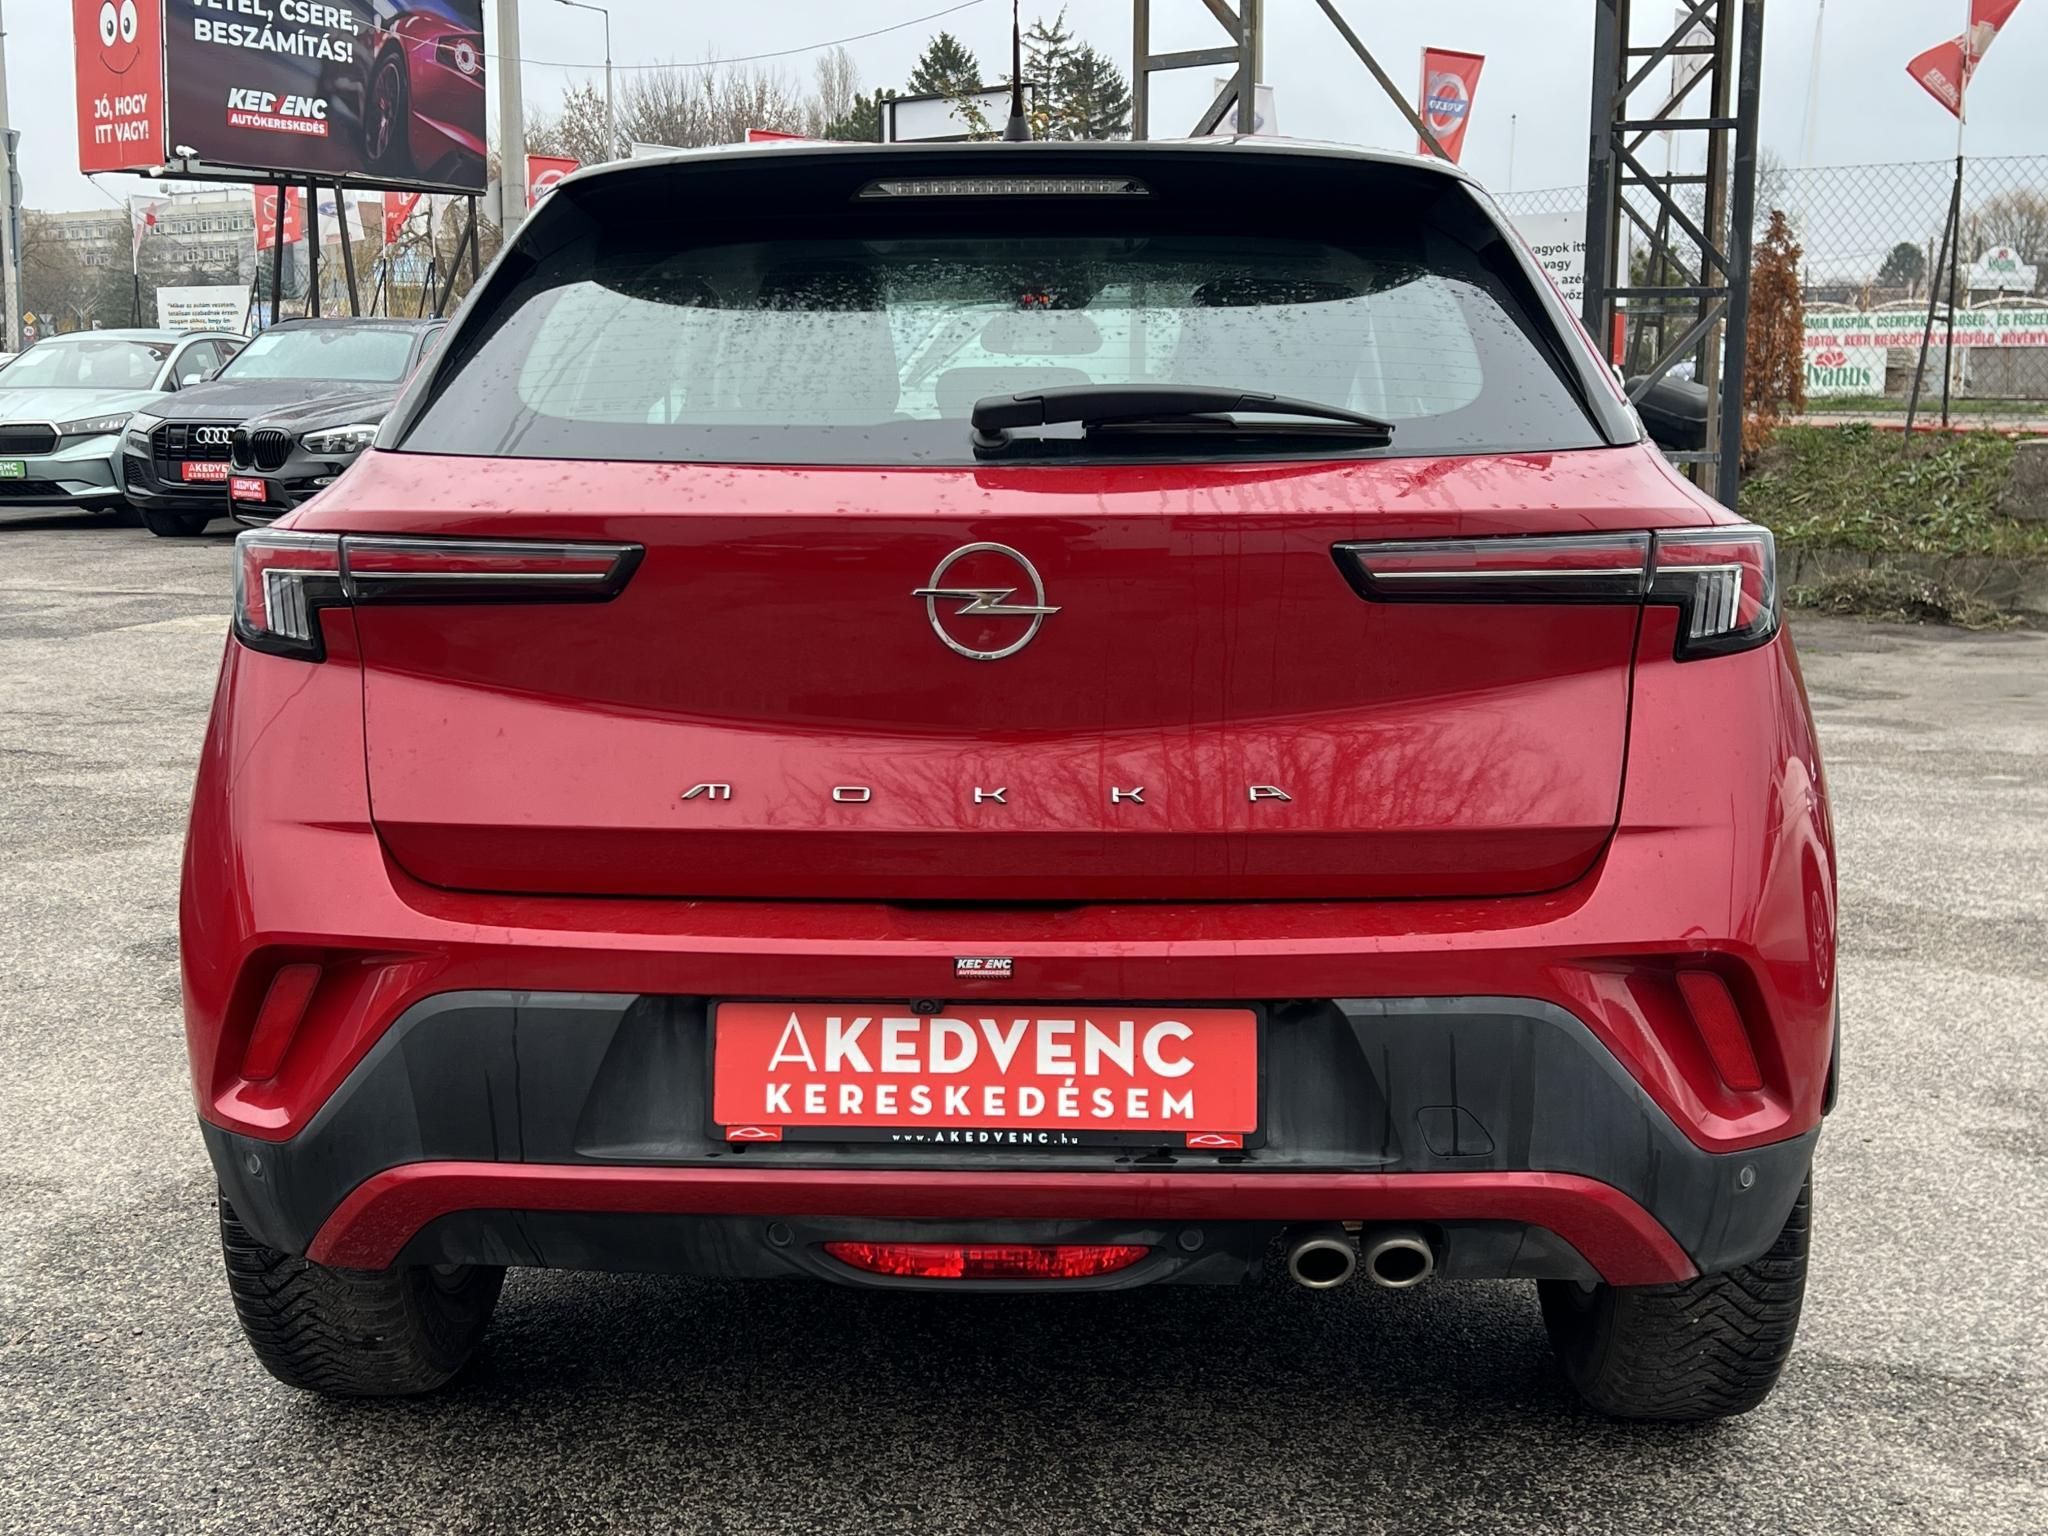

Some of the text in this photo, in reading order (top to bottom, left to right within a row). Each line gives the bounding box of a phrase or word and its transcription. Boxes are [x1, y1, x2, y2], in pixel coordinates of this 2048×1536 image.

[279, 0, 359, 36] CSERE,
[194, 18, 354, 64] BESZÁMÍTÁS!
[94, 93, 148, 120] JÓ, HOGY
[95, 119, 149, 144] ITT VAGY!
[230, 112, 326, 135] AUTÓKERESKEDÉS
[1544, 260, 1571, 271] vagy
[766, 1078, 1195, 1119] KERESKEDÉSEM
[892, 1131, 1078, 1145] www.AKEDVENC.hu
